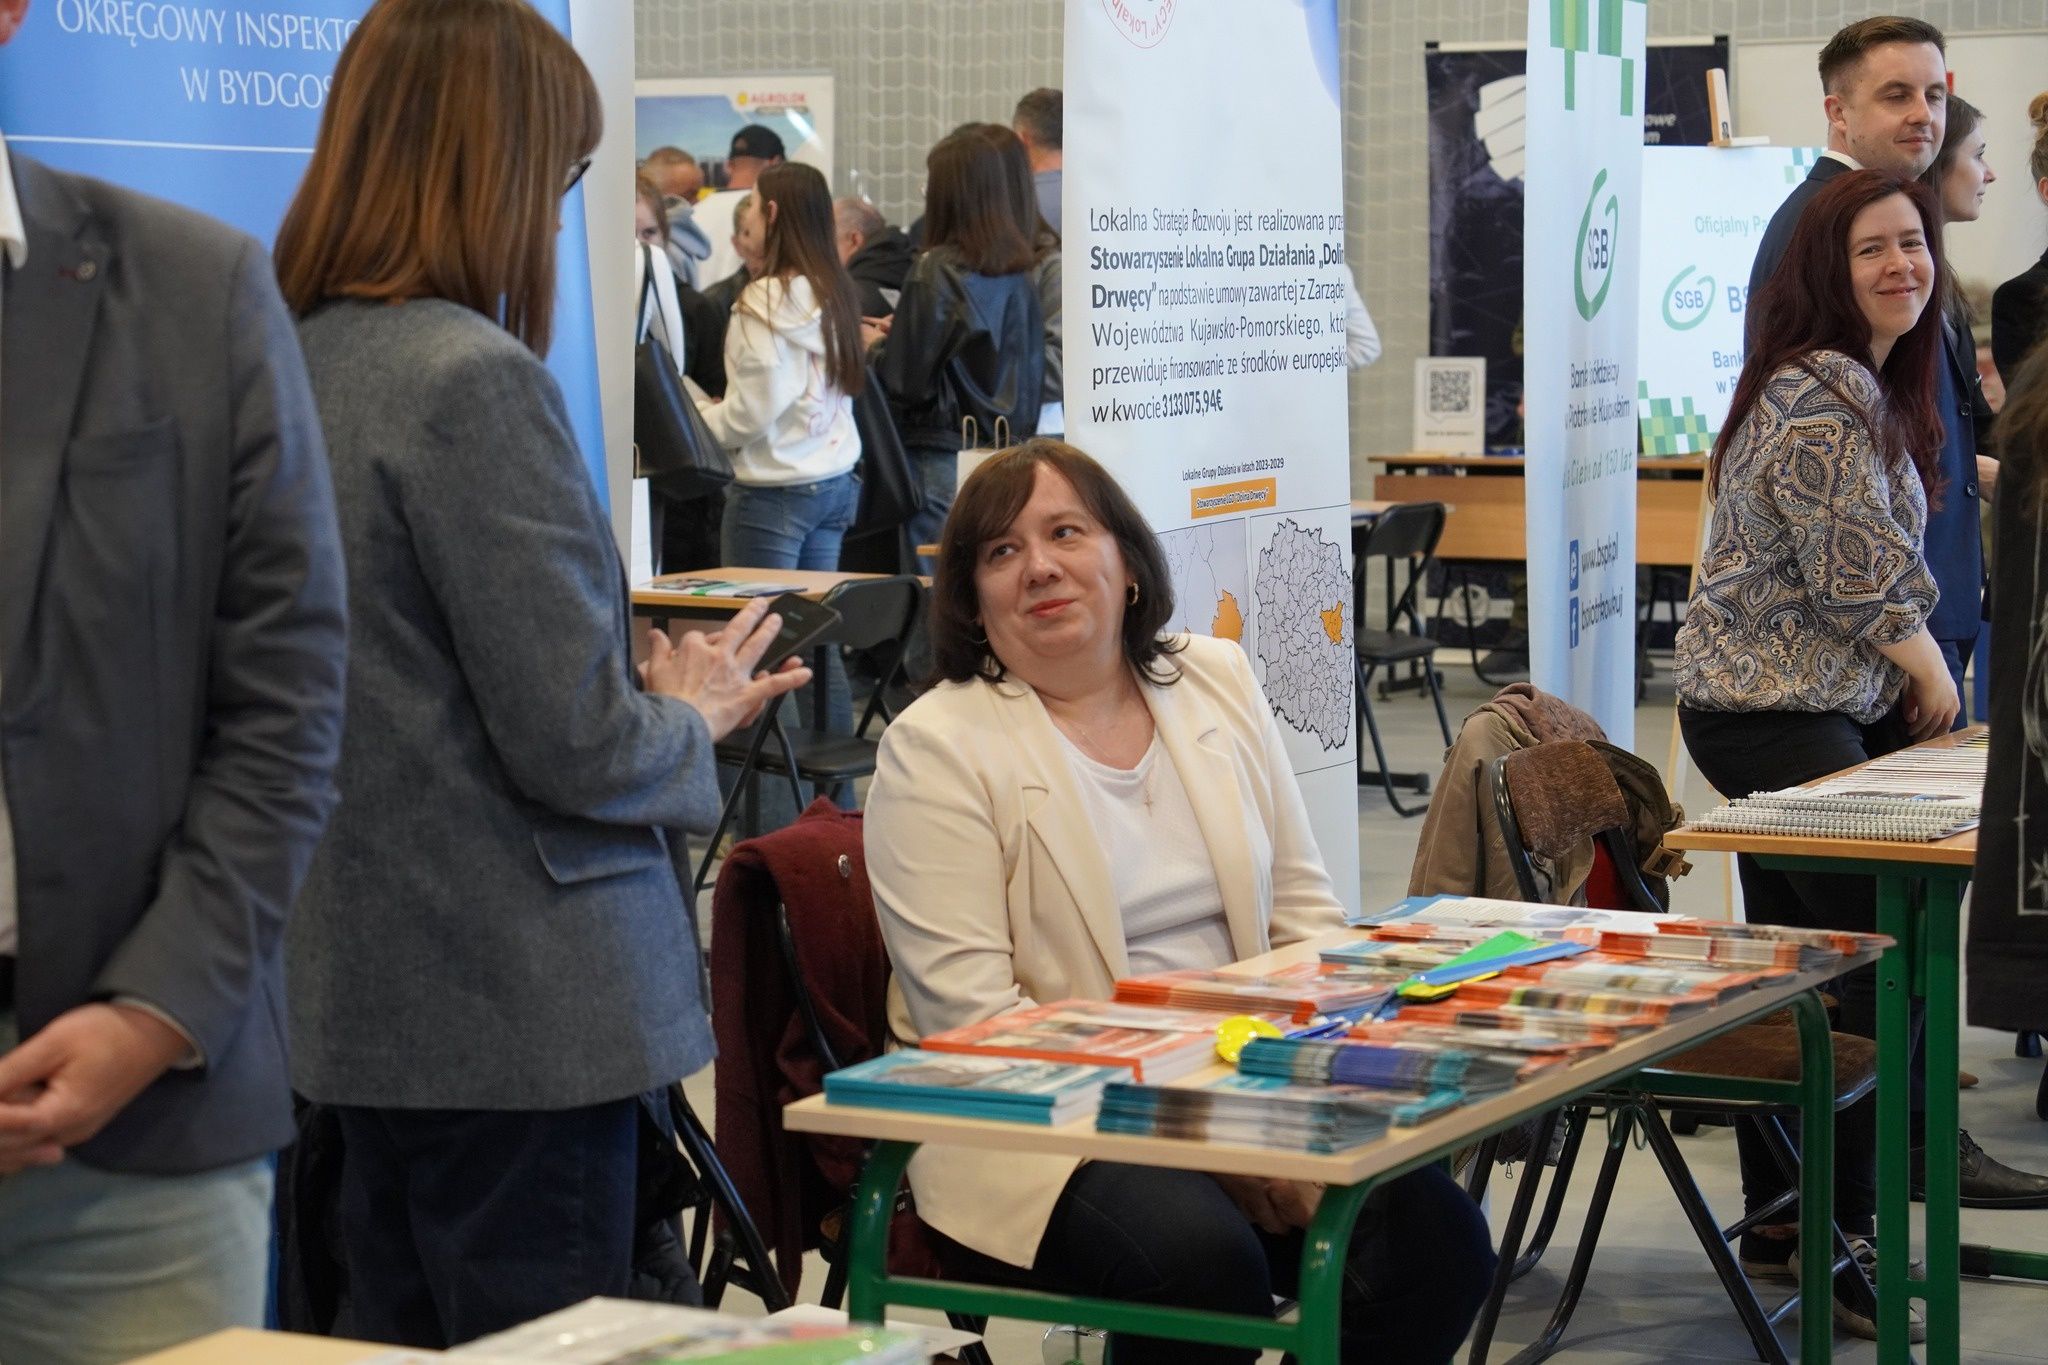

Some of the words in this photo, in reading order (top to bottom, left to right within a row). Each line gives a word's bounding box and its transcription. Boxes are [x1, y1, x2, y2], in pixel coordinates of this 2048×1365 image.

[57, 0, 226, 48] OKRĘGOWY
[180, 66, 210, 102] W
[1090, 207, 1148, 232] Lokalna
[1153, 207, 1189, 237] Strategia
[1192, 208, 1231, 237] Rozwoju
[1234, 209, 1253, 237] jest
[1258, 208, 1325, 232] realizowana
[1694, 215, 1749, 238] Oficjalny
[1090, 245, 1184, 274] Stowarzyszenie
[1186, 244, 1224, 268] Lokalna
[1226, 243, 1255, 272] Grupa
[1259, 243, 1316, 267] Działania
[1091, 281, 1157, 313] Drwęcy”
[1169, 281, 1215, 311] podstawie
[1216, 285, 1248, 308] umowy
[1249, 278, 1298, 306] zawartej
[1300, 284, 1306, 301] z
[1674, 290, 1704, 309] SGB
[1091, 320, 1184, 352] Województwa
[1190, 313, 1324, 346] Kujawsko-Pomorskiego,
[1093, 357, 1168, 391] przewiduje
[1169, 353, 1224, 380] finansowanie
[1227, 357, 1238, 375] ze
[1241, 349, 1289, 374] środków
[1570, 361, 1588, 389] Bank
[1715, 380, 1727, 394] w
[1091, 404, 1109, 423] w
[1112, 395, 1161, 422] kwocie
[1162, 388, 1224, 419] 3133075,94€
